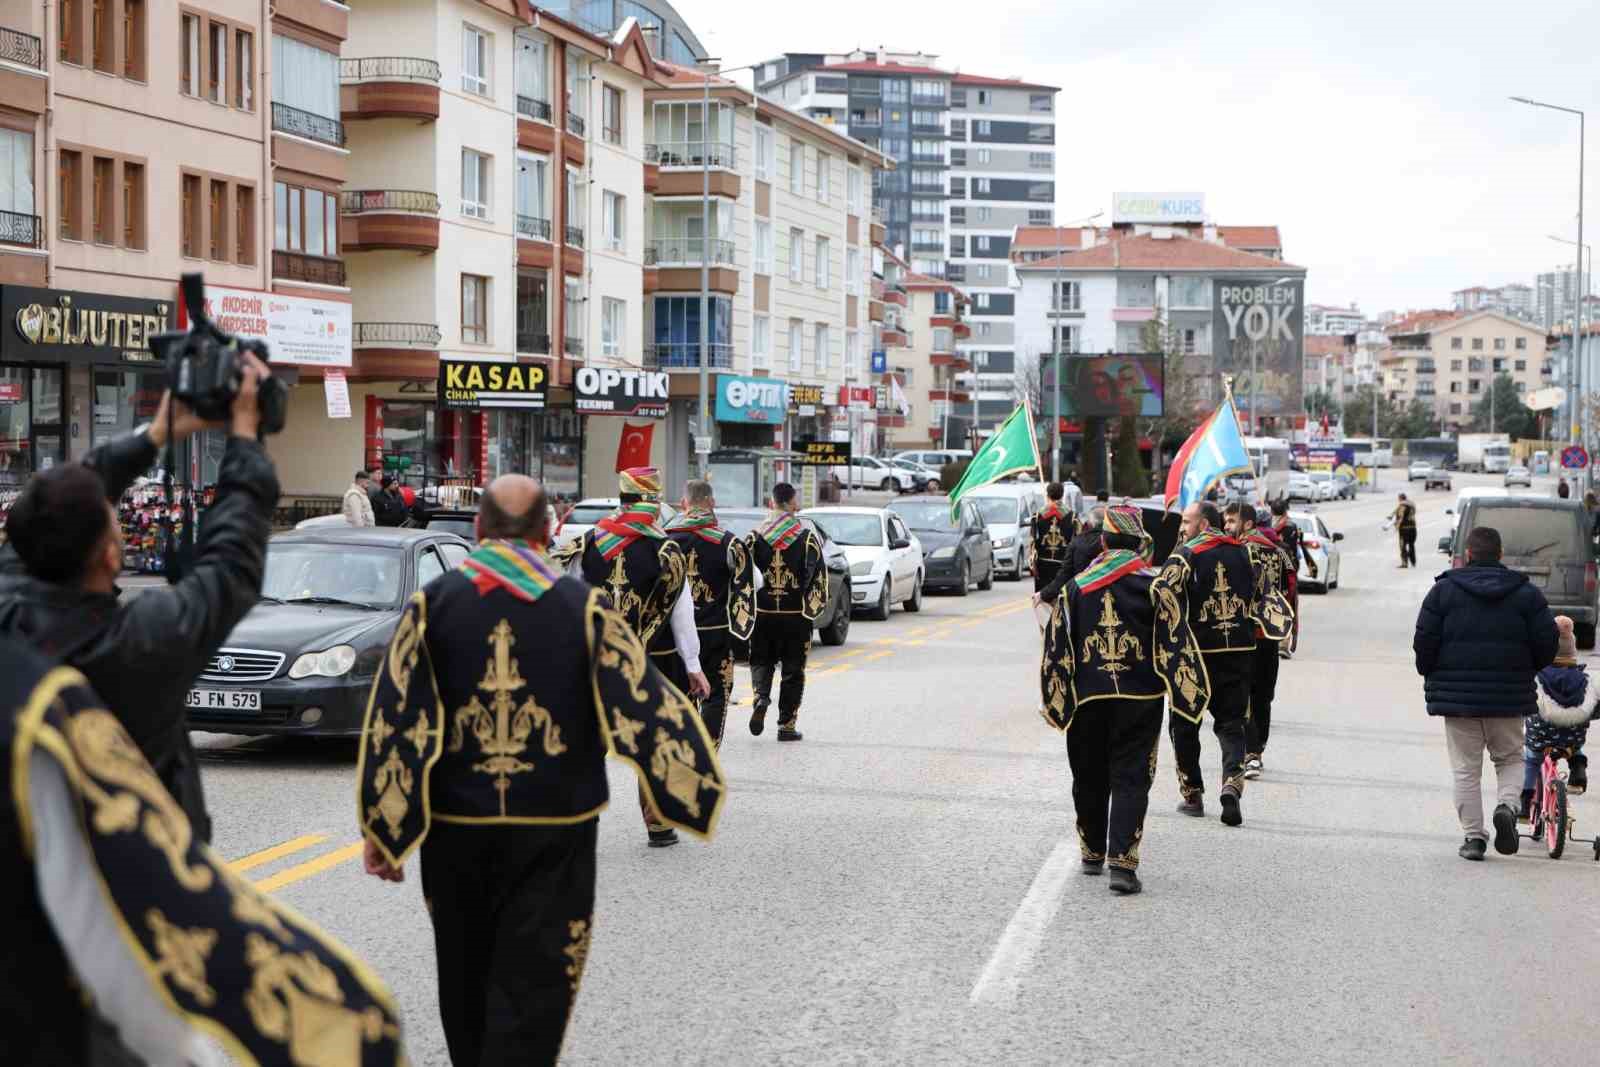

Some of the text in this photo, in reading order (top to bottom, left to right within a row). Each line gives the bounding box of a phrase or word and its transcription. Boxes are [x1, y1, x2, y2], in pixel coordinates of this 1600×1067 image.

[1221, 286, 1295, 304] PROBLEM
[1222, 304, 1295, 341] YOK
[446, 364, 544, 390] KASAP
[576, 368, 669, 399] OPTİK
[798, 455, 848, 465] MLAK
[209, 692, 225, 706] FN
[232, 693, 257, 708] 579
